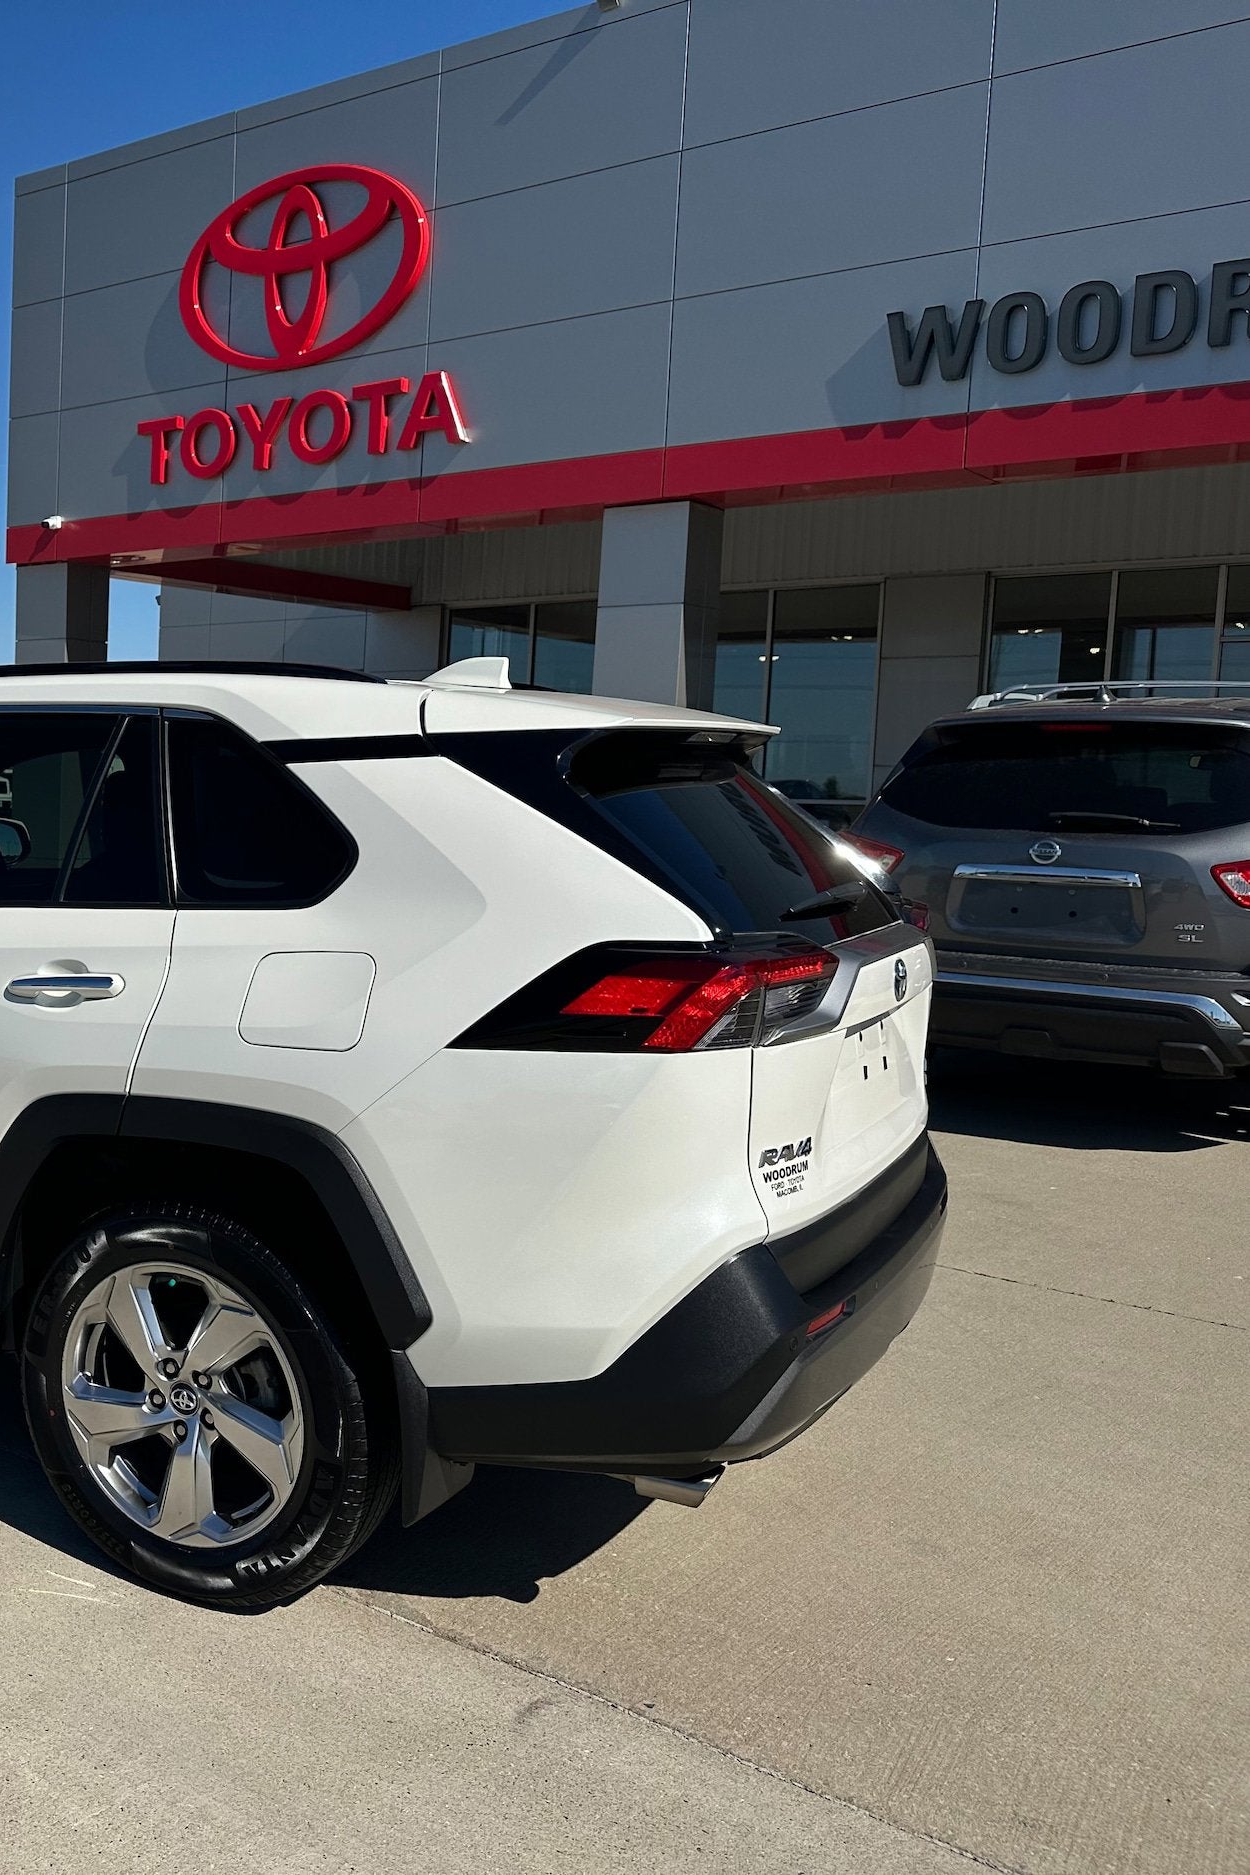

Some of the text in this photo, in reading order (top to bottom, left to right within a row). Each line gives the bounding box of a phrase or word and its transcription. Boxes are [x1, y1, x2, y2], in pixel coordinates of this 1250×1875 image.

[886, 258, 1250, 387] WOODR
[137, 370, 470, 485] TOYOTA
[1173, 923, 1205, 931] 4WD
[1177, 934, 1204, 943] SL
[758, 1136, 812, 1168] RAV4
[762, 1160, 808, 1183] WOODRUM
[771, 1175, 804, 1191] FORD TOYOTA
